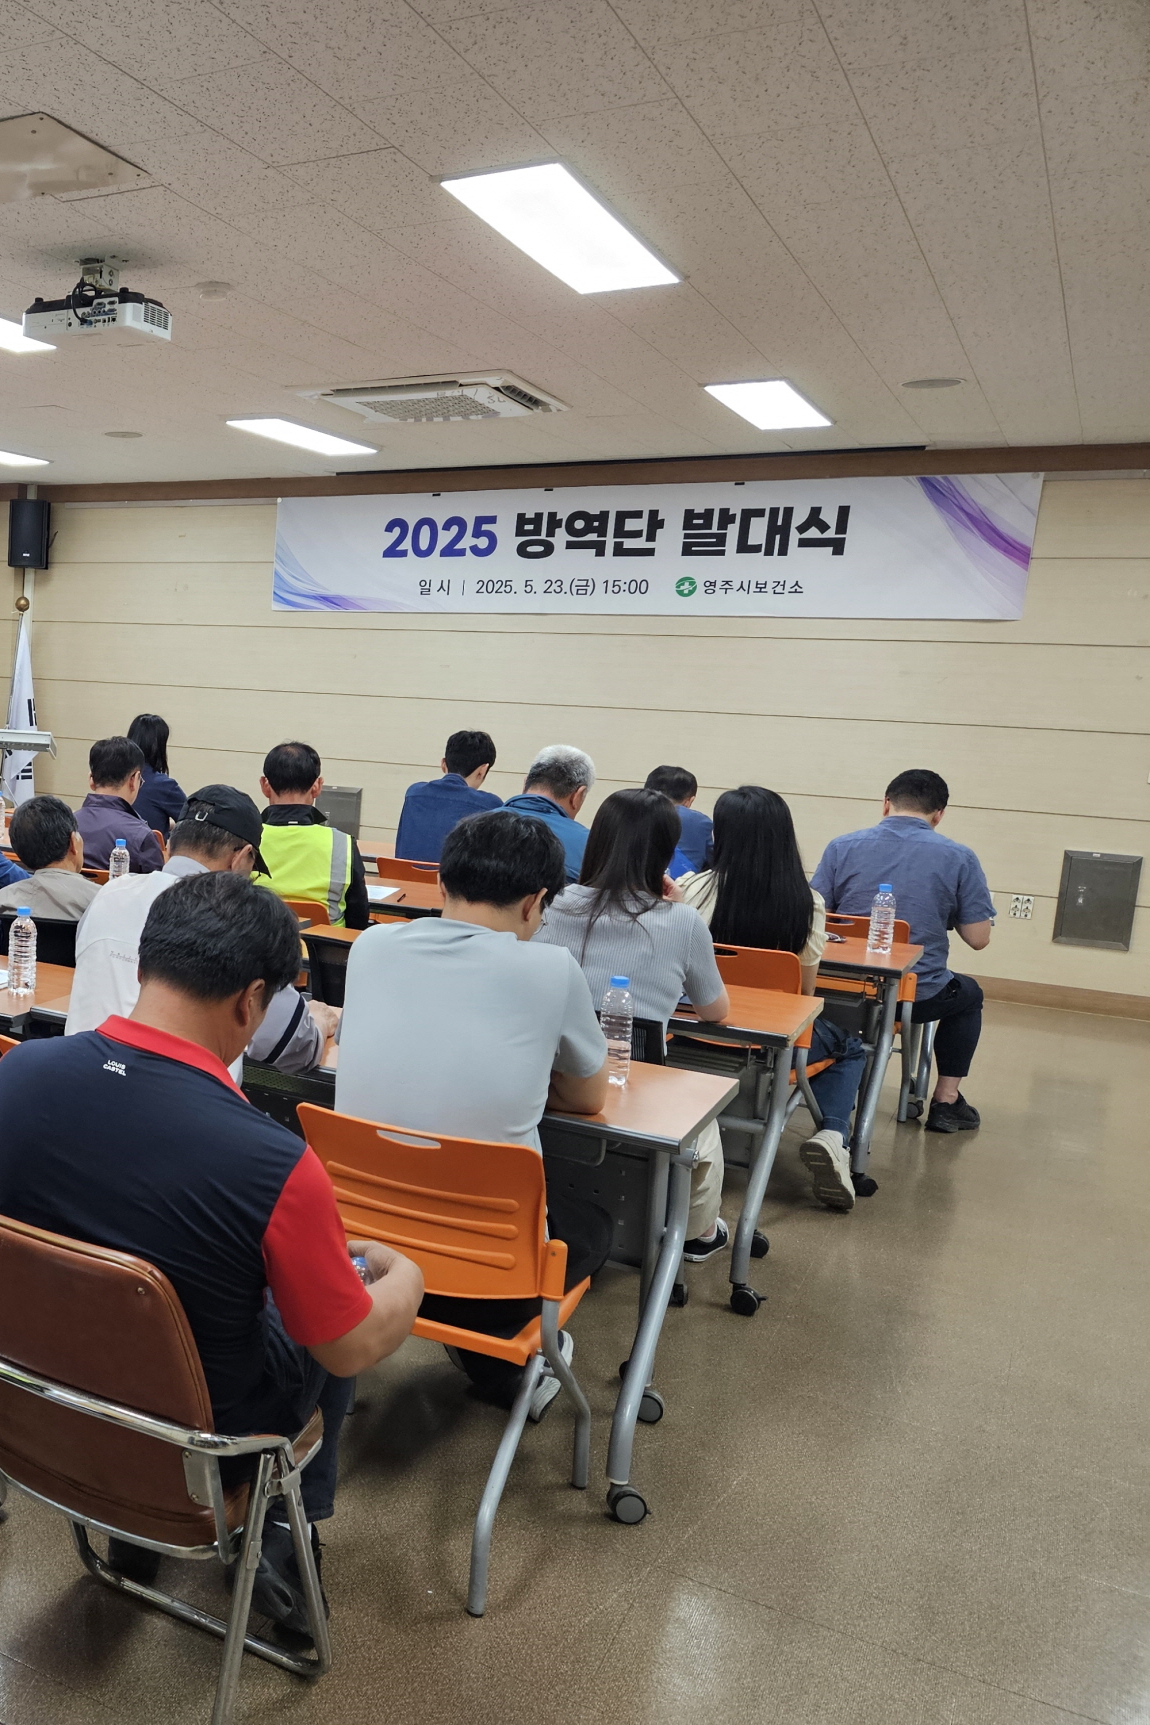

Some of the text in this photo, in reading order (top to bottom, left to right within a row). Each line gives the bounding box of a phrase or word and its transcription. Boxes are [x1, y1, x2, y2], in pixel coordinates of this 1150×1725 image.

[382, 505, 851, 560] 2025 방역단 발대식
[475, 578, 518, 595] 2025.
[523, 579, 538, 595] 5.
[542, 577, 596, 597] 23.(금)
[602, 578, 649, 595] 15:00
[703, 579, 804, 595] 영주시보건소
[103, 1063, 126, 1076] CASTEL
[107, 1060, 126, 1070] LOUIS
